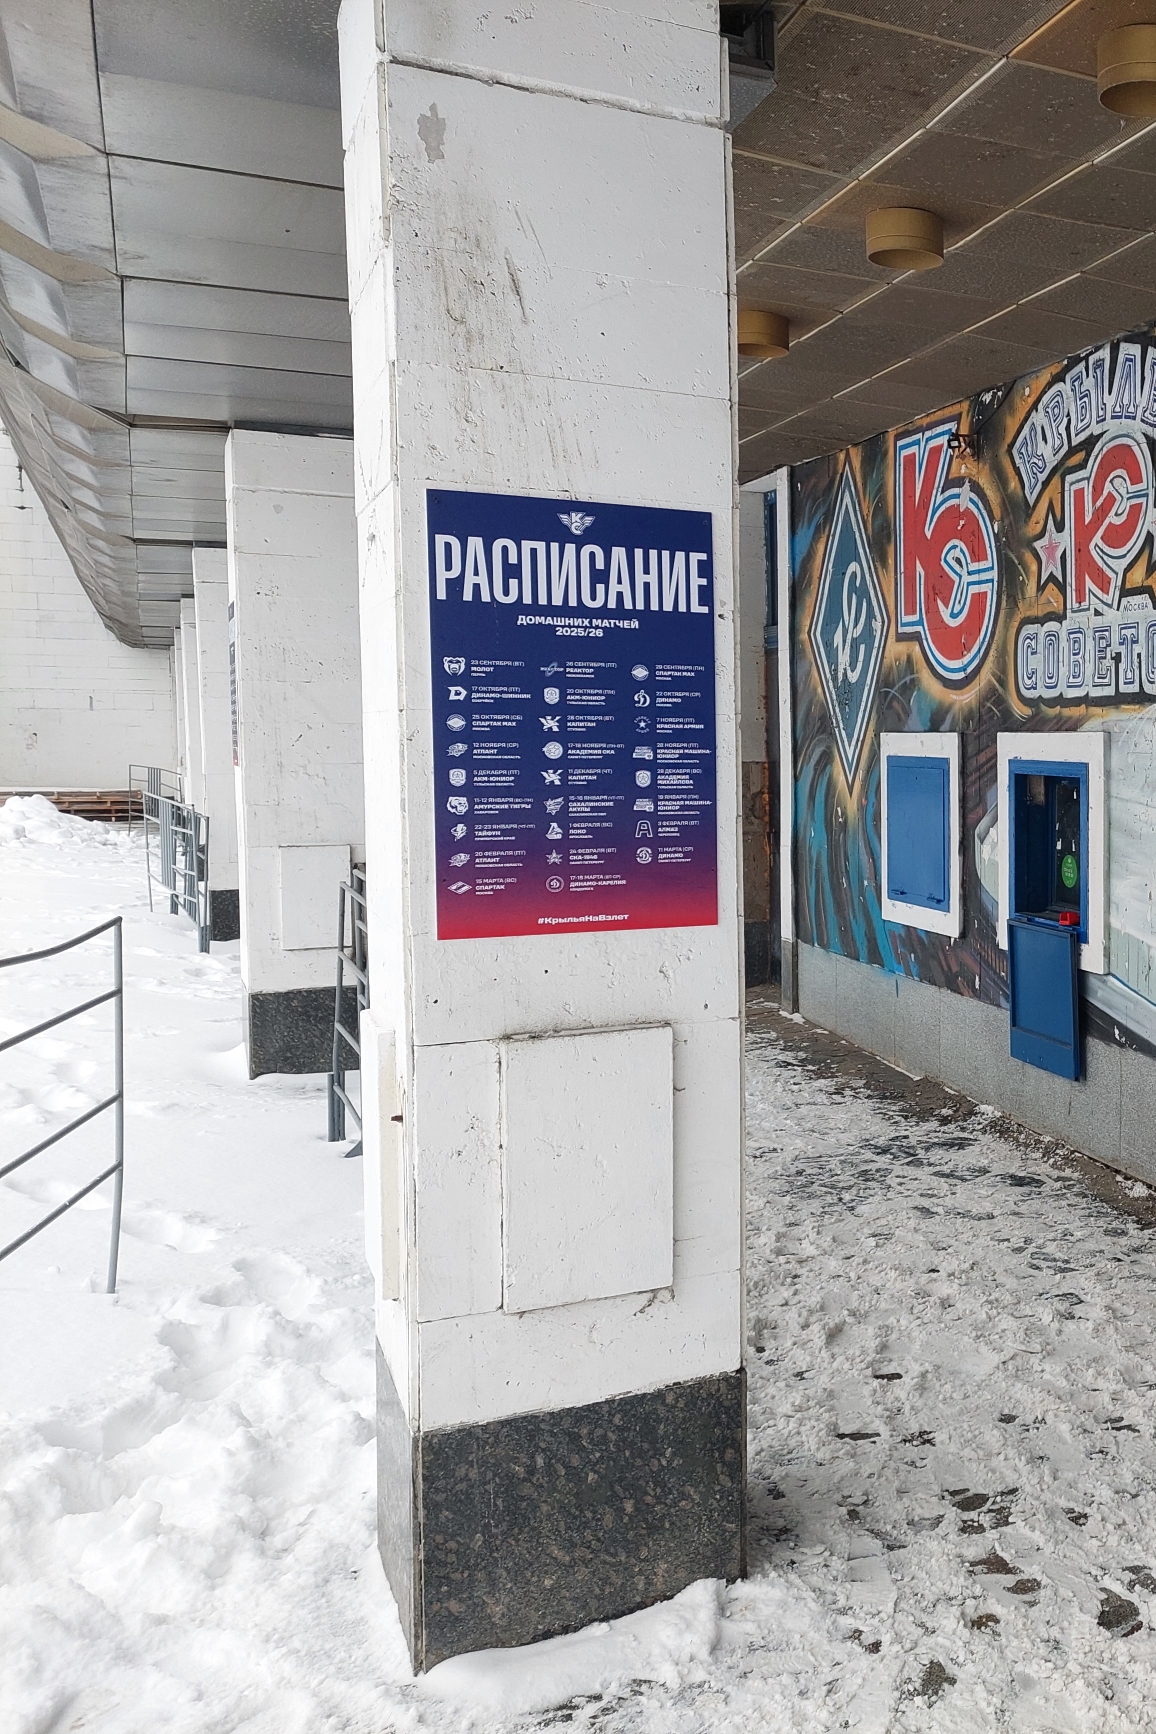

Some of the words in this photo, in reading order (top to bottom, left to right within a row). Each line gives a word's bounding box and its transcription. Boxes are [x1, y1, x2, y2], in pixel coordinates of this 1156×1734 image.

[435, 534, 709, 614] РАСПИСАНИЕ
[516, 614, 590, 627] ДОМАШНИХ
[592, 618, 639, 630] МАТЧЕЙ
[556, 627, 604, 638] 2025/26
[538, 914, 630, 925] #КрыльяНаВзлет
